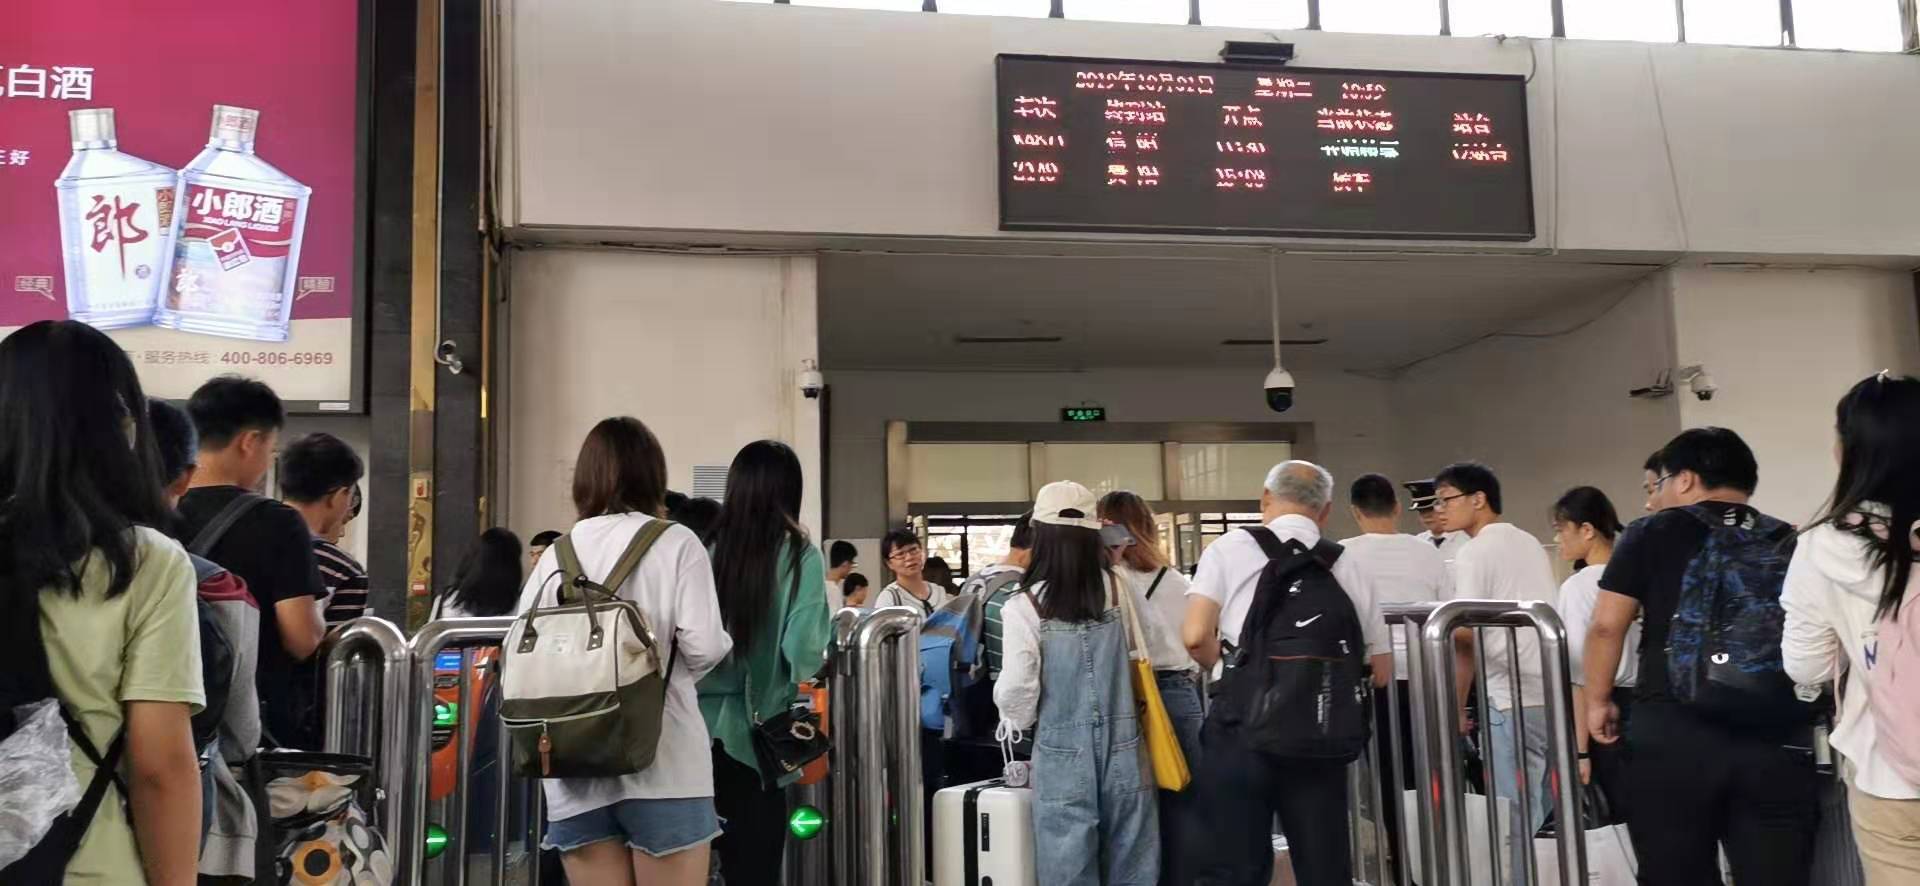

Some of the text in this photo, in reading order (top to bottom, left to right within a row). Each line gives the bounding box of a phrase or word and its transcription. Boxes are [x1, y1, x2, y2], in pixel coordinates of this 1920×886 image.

[191, 188, 285, 225] 小郎酒
[220, 351, 334, 366] 400-806-6969
